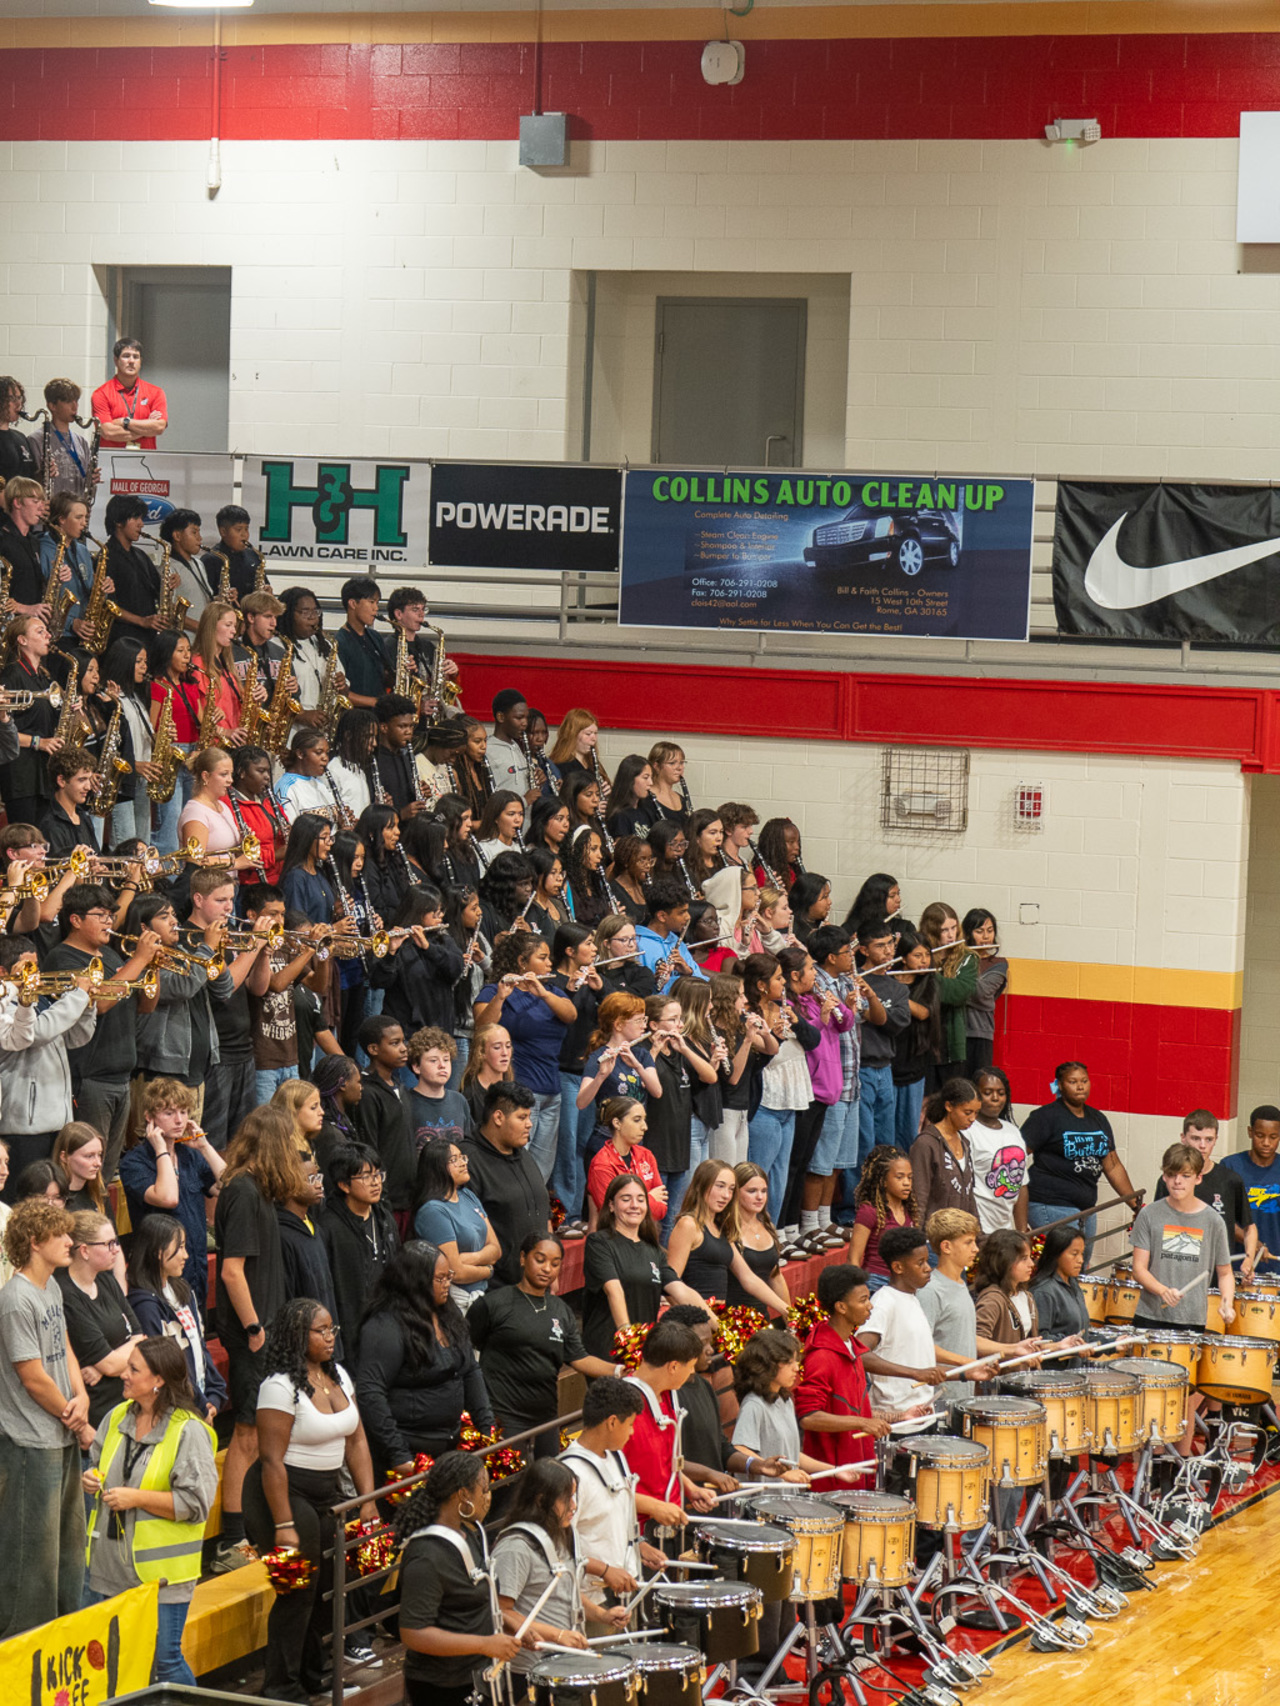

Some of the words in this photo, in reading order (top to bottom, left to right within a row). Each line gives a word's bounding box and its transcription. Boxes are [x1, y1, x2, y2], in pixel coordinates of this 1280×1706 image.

[112, 480, 129, 492] MALL
[130, 482, 139, 492] OF
[140, 483, 169, 494] GEORGIA
[652, 476, 769, 505] COLLINS
[776, 479, 851, 507] AUTO
[862, 481, 956, 510] CLEAN
[965, 484, 1005, 511] UP
[259, 461, 410, 548] H&H
[435, 501, 610, 534] POWERADE
[694, 510, 731, 520] Complete
[733, 511, 752, 519] Auto
[753, 511, 789, 522] Detailing
[259, 545, 313, 558] LAWN
[317, 547, 368, 560] CARE
[371, 549, 408, 562] INC.
[692, 578, 717, 587] Office:
[720, 578, 778, 588] 706-291-0208
[691, 588, 707, 597] Fax:
[709, 589, 768, 599] 706-291-0208
[837, 586, 850, 595] Bill
[851, 587, 858, 595] &
[860, 587, 880, 596] Faith
[881, 587, 910, 597] Collins
[917, 588, 949, 598] Owners
[871, 597, 881, 605] 15
[883, 597, 903, 606] West
[906, 598, 924, 606] 10th
[925, 598, 949, 607] Street
[876, 606, 902, 616] Rome,
[904, 607, 919, 616] GA
[920, 607, 947, 617] 30165
[720, 617, 736, 627] Why
[738, 618, 759, 627] Settle
[760, 619, 771, 627] for
[773, 619, 790, 628] Less
[792, 619, 815, 629] When
[816, 620, 832, 630] You
[833, 621, 851, 630] Can
[852, 622, 868, 631] Get
[869, 622, 882, 631] the
[883, 623, 903, 632] Best!
[1160, 1253, 1199, 1263] patagonia
[47, 1645, 86, 1692] KICK
